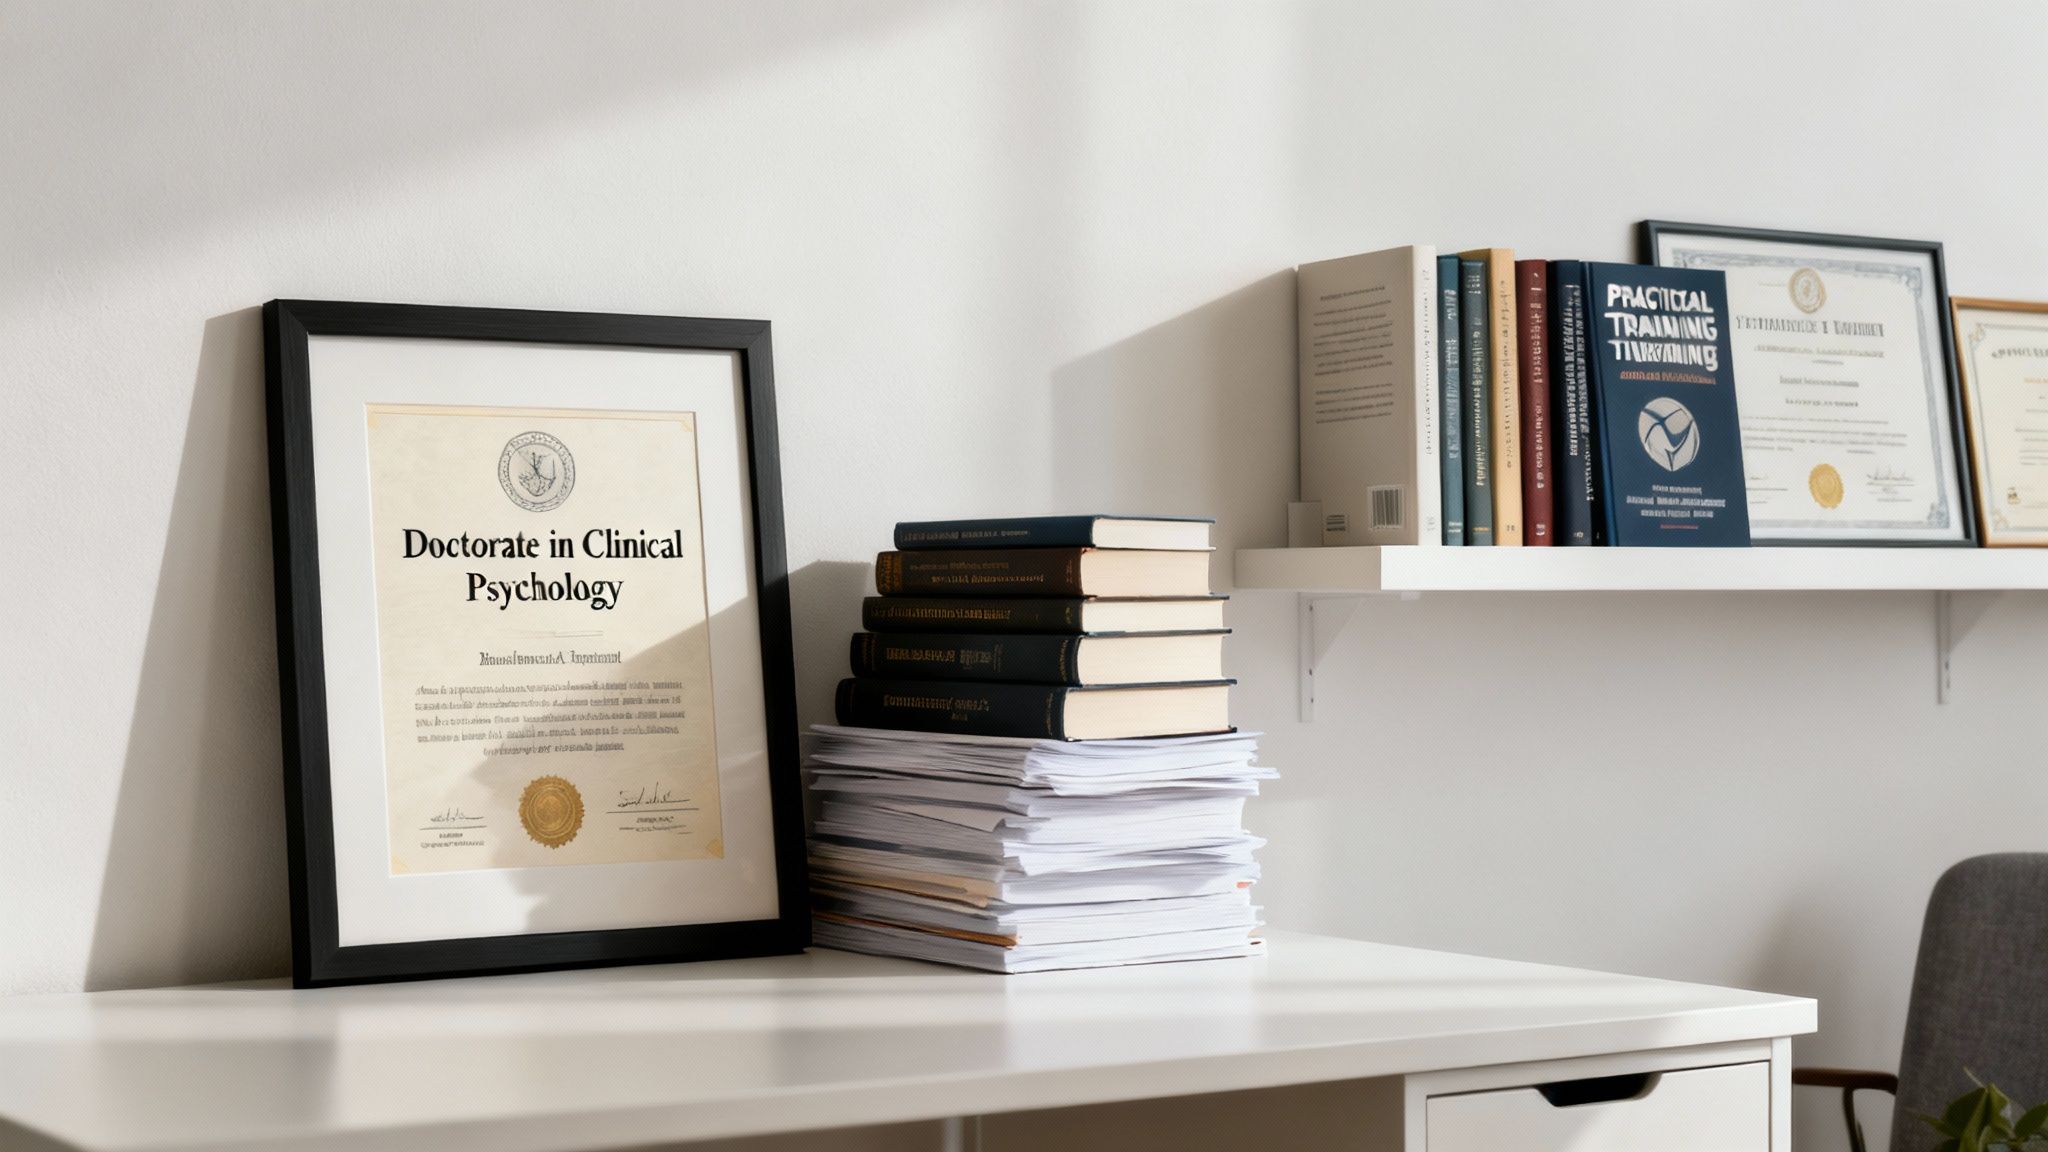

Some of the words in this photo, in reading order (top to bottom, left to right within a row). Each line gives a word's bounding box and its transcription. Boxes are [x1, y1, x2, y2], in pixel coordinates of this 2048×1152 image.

[1604, 312, 1718, 341] TRAINING
[402, 528, 541, 559] Doctorate
[550, 529, 575, 559] in
[582, 528, 684, 559] Clinical
[466, 571, 624, 611] Psychology
